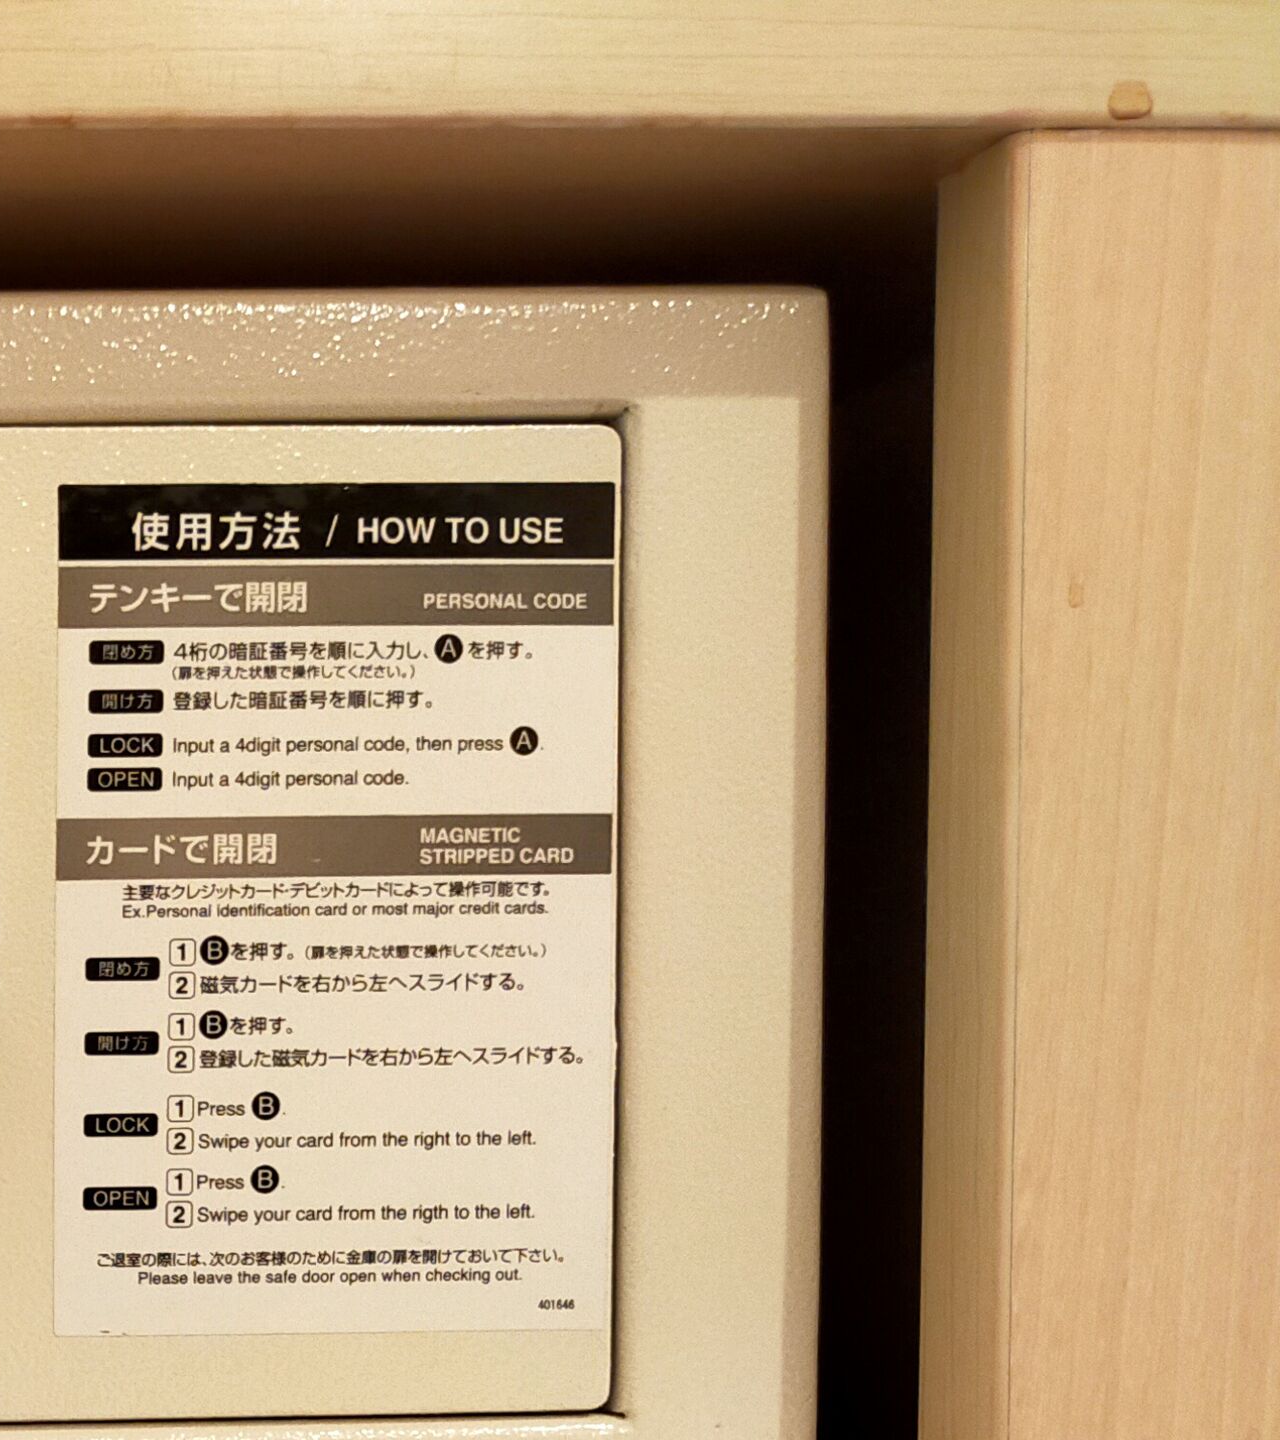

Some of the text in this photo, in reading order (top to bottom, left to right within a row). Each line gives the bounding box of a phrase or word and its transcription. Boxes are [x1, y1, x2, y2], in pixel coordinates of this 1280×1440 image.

[131, 511, 300, 551] 使用方法
[355, 515, 437, 547] HOW
[444, 516, 489, 544] TO
[497, 515, 566, 547] USE
[89, 581, 307, 615] テンキーで開閉
[421, 591, 589, 612] PERSONAL CODE
[100, 642, 156, 662] 閉め方
[102, 693, 153, 710] 開け方
[171, 688, 435, 712] 登録した暗証番号を順に押す。
[99, 736, 154, 754] LOCK
[173, 737, 215, 757] Input
[219, 740, 230, 753] a
[235, 737, 281, 757] 4digit
[285, 736, 359, 756] personal
[363, 735, 410, 753] code,
[415, 735, 453, 752] then
[457, 738, 504, 755] press
[97, 771, 155, 788] OPEN
[172, 769, 409, 792] Input a 4digit personal code.
[418, 826, 522, 845] MAGNETIC
[86, 833, 277, 865] カードで開閉
[418, 846, 576, 867] STRIPPED CARD
[216, 903, 310, 919] identification
[314, 902, 348, 917] card
[351, 904, 368, 916] or
[371, 902, 409, 916] most
[412, 901, 455, 919] major
[458, 901, 499, 915] credit
[504, 900, 549, 915] cards.
[98, 961, 149, 978] 閉め方
[199, 972, 524, 995] 磁気カードを右から左へスライドする。
[97, 1035, 147, 1052] 開け方
[199, 1046, 583, 1069] 登録した磁気カードを右から左へスライドする。
[196, 1099, 246, 1118] Press
[95, 1116, 150, 1134] LOCK
[198, 1133, 250, 1151] Swipe
[254, 1136, 293, 1151] your
[296, 1132, 334, 1148] card
[339, 1131, 377, 1148] from
[382, 1131, 409, 1147] the
[414, 1131, 450, 1151] right
[455, 1131, 472, 1147] to
[476, 1130, 502, 1146] the
[507, 1129, 536, 1146] left.
[195, 1173, 246, 1192] Press
[93, 1190, 149, 1207] OPEN
[197, 1206, 249, 1225] Swipe
[253, 1209, 292, 1225] your
[295, 1205, 333, 1222] card
[337, 1205, 376, 1221] from
[380, 1205, 407, 1221] the
[412, 1204, 449, 1224] rigth
[454, 1205, 470, 1220] to
[474, 1204, 501, 1220] the
[506, 1203, 535, 1219] left.
[138, 1268, 522, 1286] Please leave the safe door open when checking out.
